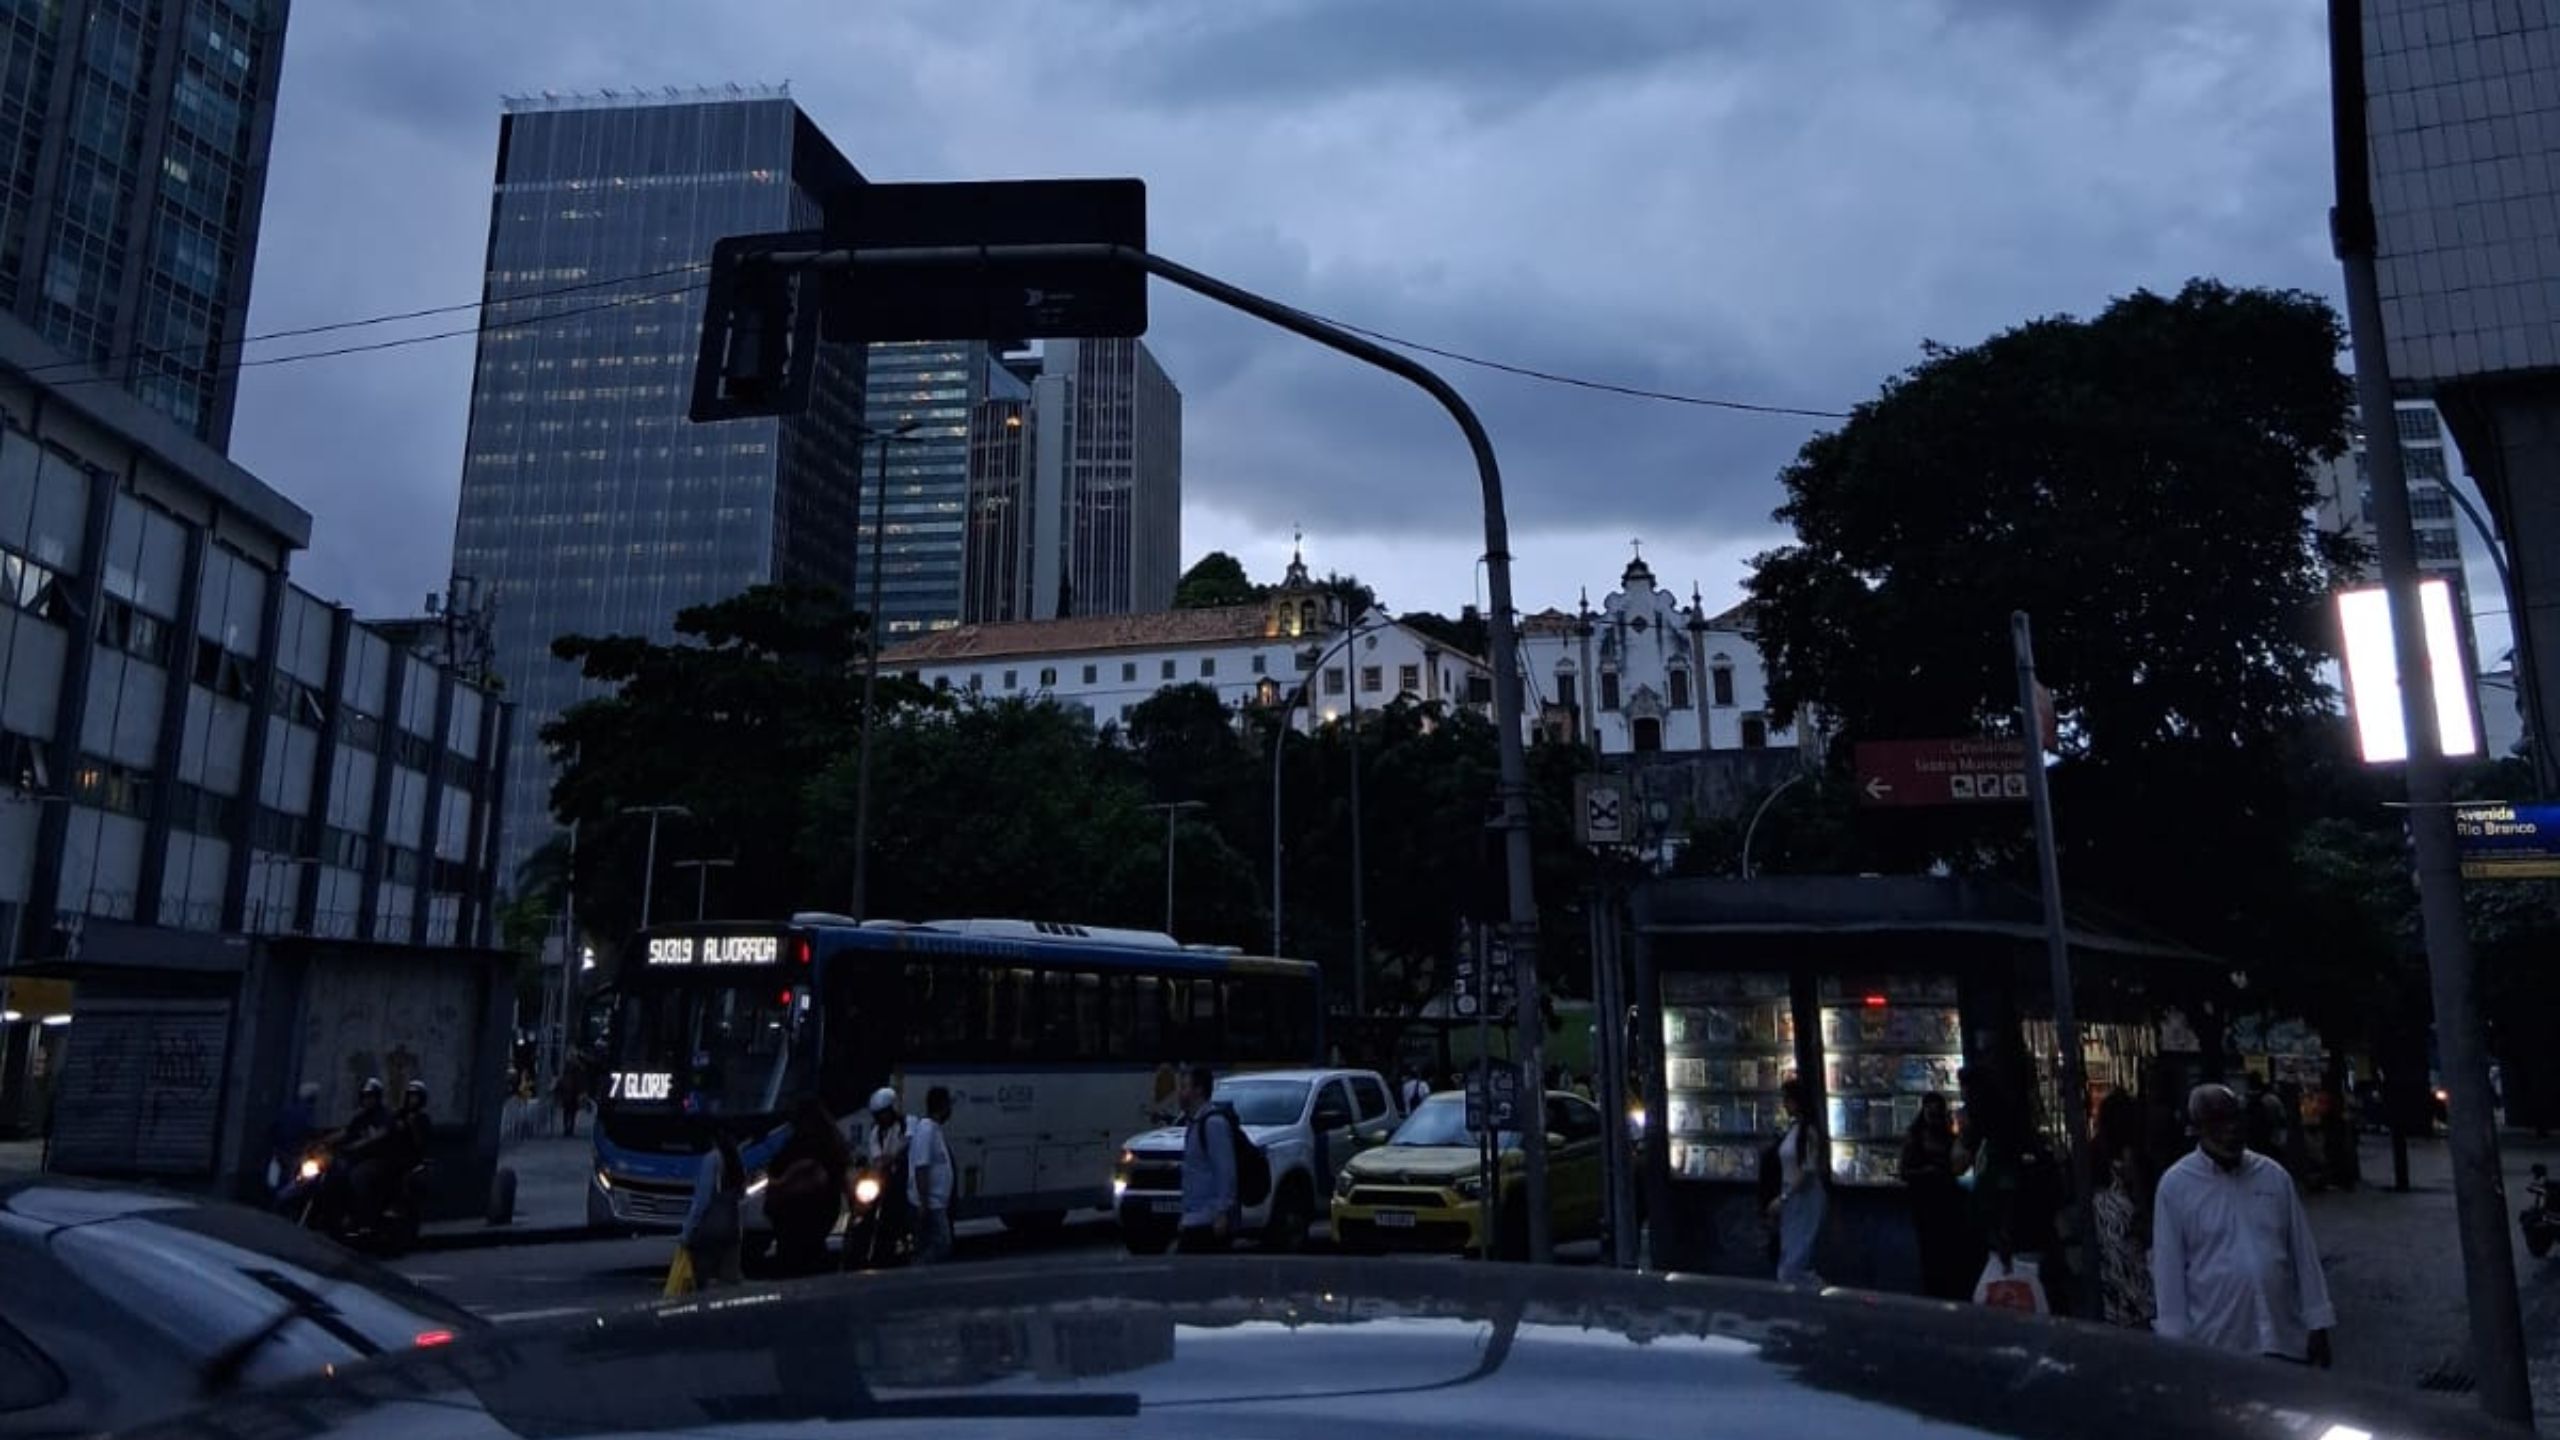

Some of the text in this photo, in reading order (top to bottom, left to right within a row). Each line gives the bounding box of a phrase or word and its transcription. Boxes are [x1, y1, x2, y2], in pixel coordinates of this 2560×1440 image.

[2457, 806, 2516, 821] Avenida
[2457, 821, 2537, 836] Rio Branco
[703, 936, 778, 964] ALVORADA
